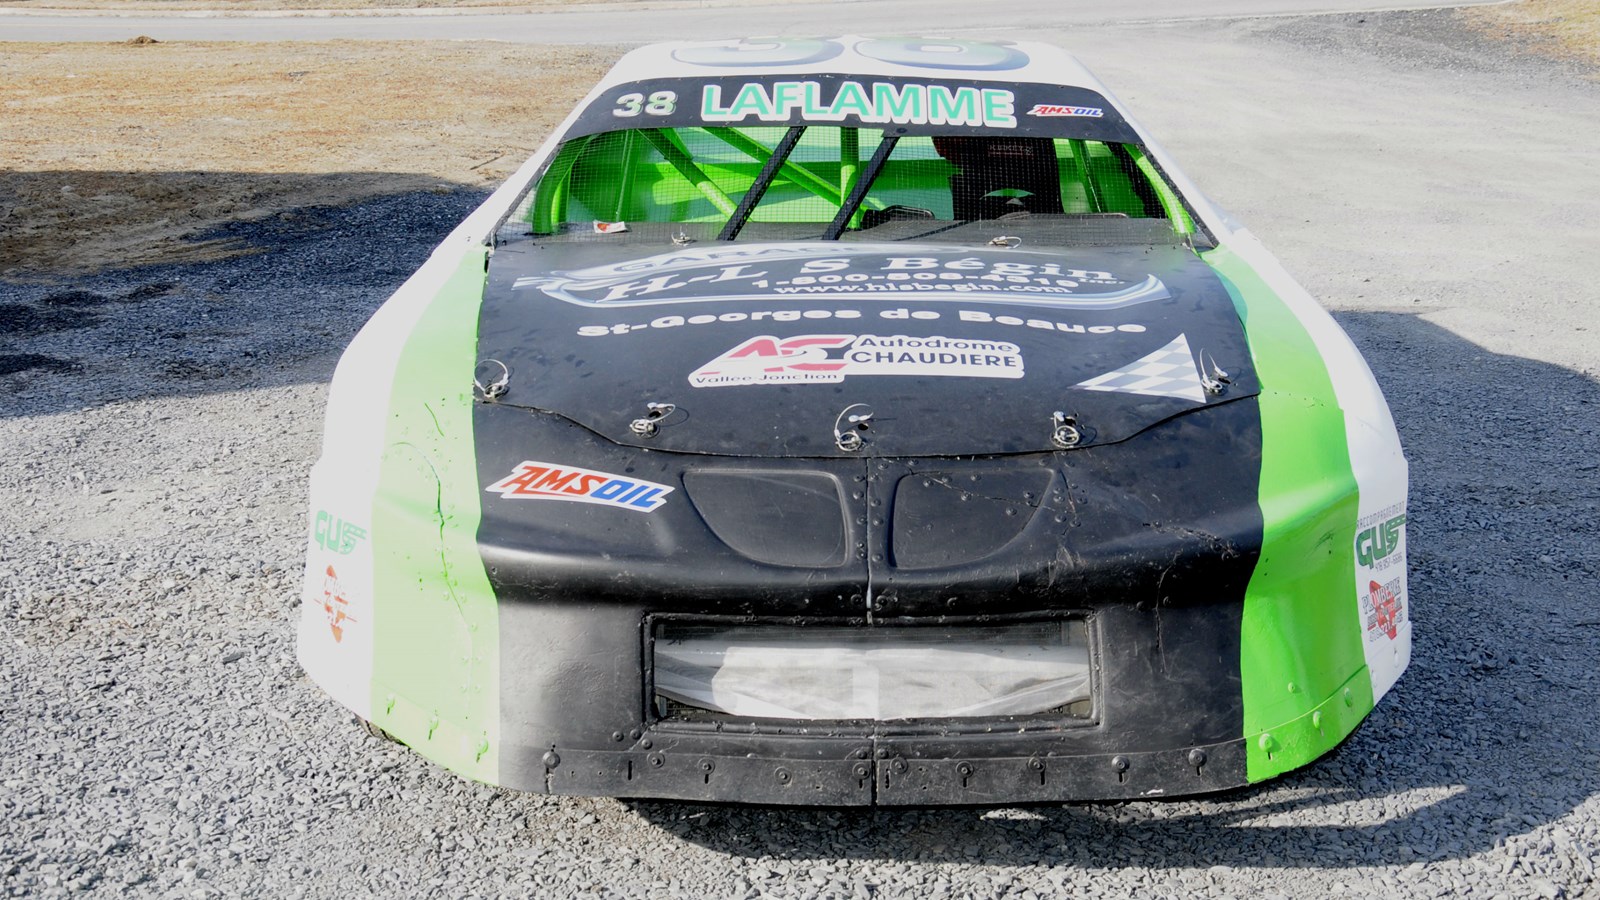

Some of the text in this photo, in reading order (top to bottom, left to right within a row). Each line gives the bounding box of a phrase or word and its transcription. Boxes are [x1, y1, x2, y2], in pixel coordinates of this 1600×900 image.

[612, 91, 678, 117] 38
[701, 81, 1017, 128] LAFLAMME
[1032, 105, 1102, 116] AMSOIL
[880, 257, 1118, 281] Bégin
[773, 281, 1073, 294] www.hlsbegin.com
[577, 308, 1148, 337] St-Georges de Beauce
[859, 335, 1013, 352] Autodrome
[850, 351, 1018, 368] CHAUDIERE
[758, 373, 838, 384] Jonction
[499, 464, 664, 509] AMSOIL
[314, 510, 367, 555] GUS
[1356, 513, 1406, 570] GUS
